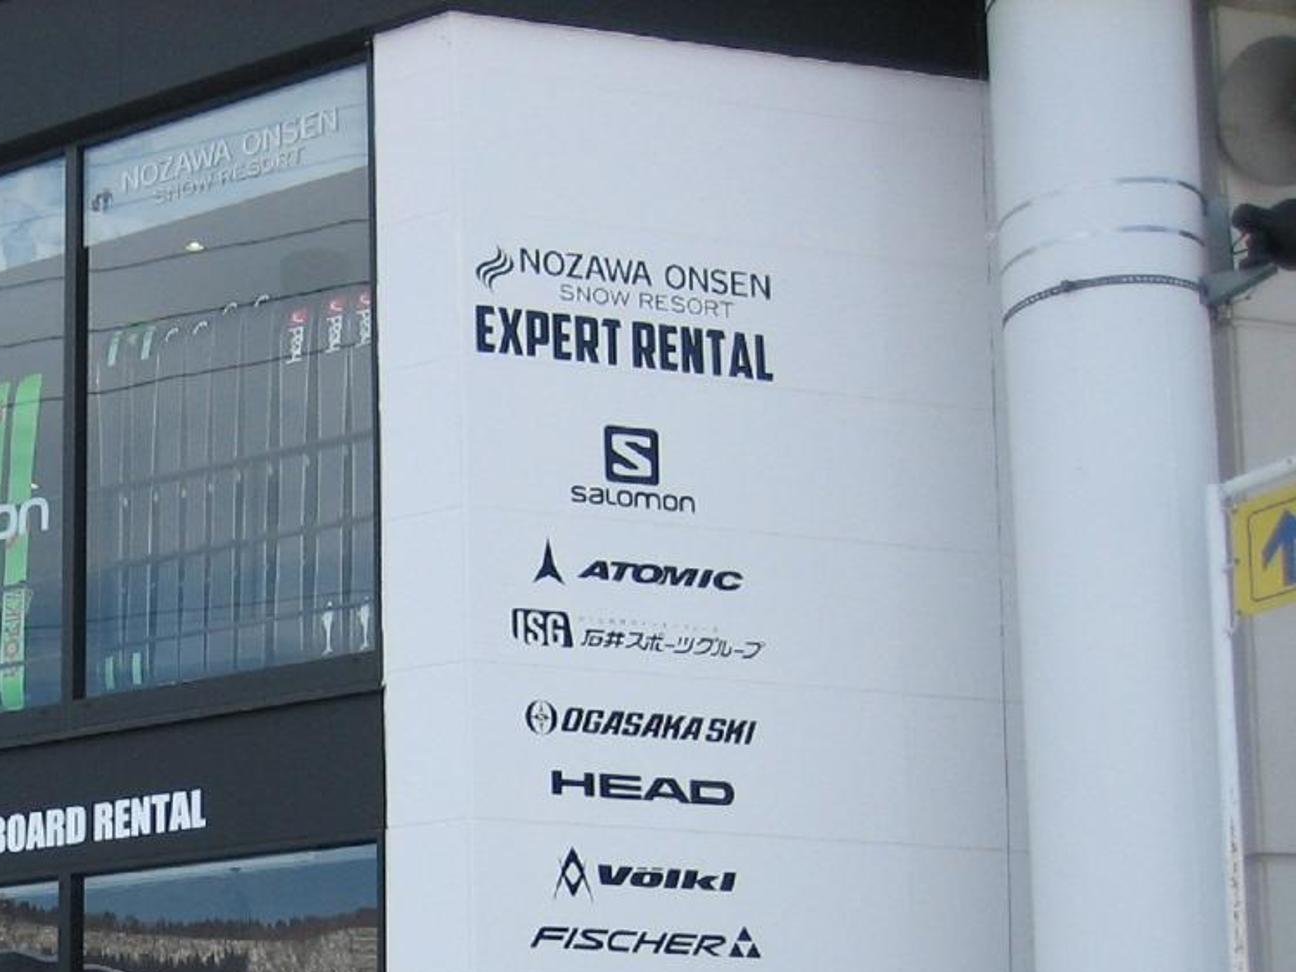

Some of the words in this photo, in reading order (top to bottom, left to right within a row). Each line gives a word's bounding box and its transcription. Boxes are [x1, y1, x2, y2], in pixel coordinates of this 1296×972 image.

[121, 139, 232, 191] NOZAWA
[243, 106, 340, 155] ONSEN
[520, 248, 652, 287] NOZAWA
[665, 264, 772, 300] ONSEN
[559, 283, 631, 307] SNOW
[639, 293, 734, 319] RESORT
[475, 305, 621, 365] EXPERT
[632, 320, 774, 382] RENTAL
[578, 560, 744, 591] ATOMIC
[581, 629, 766, 659] 石井スポーツグループ
[561, 707, 703, 742] OGASAKA
[705, 718, 757, 745] SKI
[551, 770, 736, 806] HEAD
[93, 789, 206, 842] RENTAL
[530, 926, 727, 957] FISCHER
